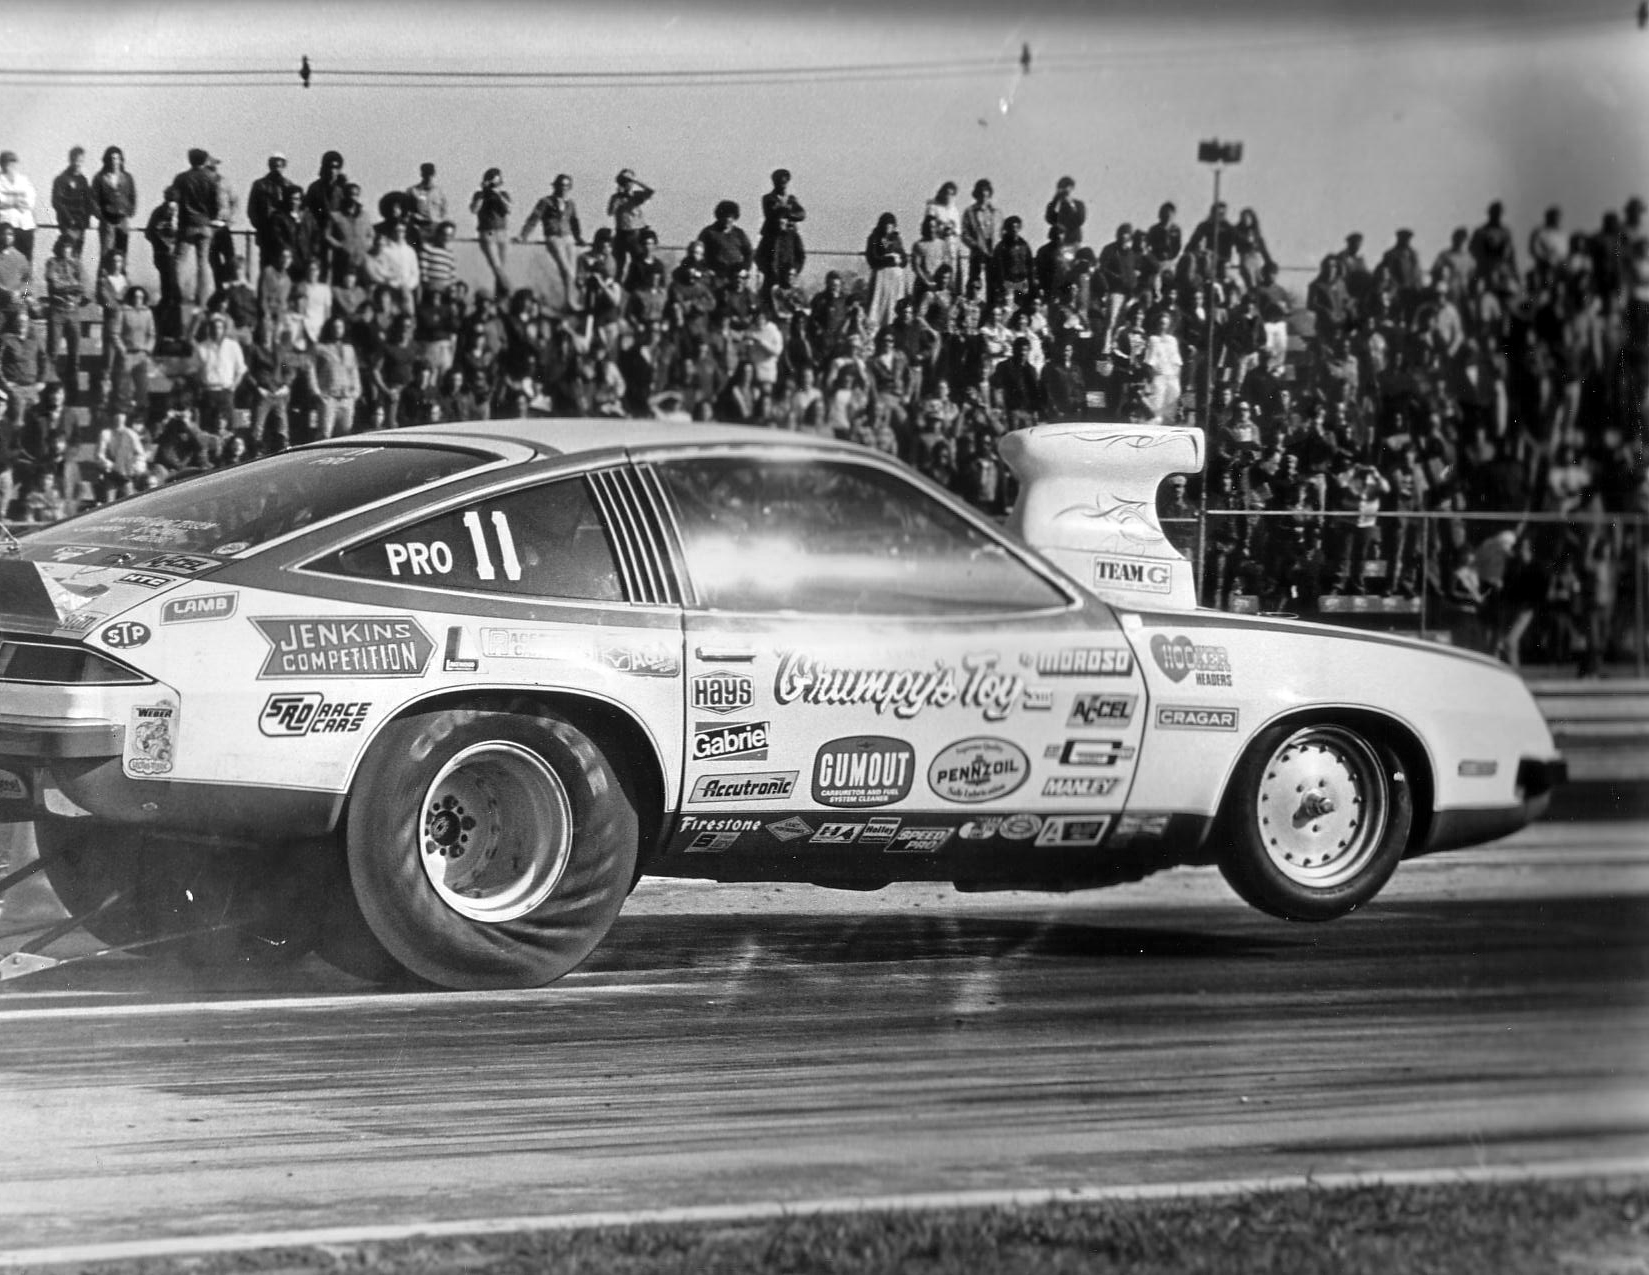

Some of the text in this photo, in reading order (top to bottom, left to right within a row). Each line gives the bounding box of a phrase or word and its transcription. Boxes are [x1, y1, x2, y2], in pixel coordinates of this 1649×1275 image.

[385, 510, 522, 581] PRO 11
[1096, 560, 1170, 584] TEAM G
[173, 597, 228, 614] LAMB
[107, 623, 145, 645] STP
[280, 623, 412, 651] JENKINS
[282, 641, 418, 672] COMPETITION
[1160, 643, 1232, 672] HOOKER
[773, 645, 1027, 722] Grumpy's Toy
[1195, 672, 1233, 687] HEADERS
[694, 678, 752, 706] Hays
[136, 707, 173, 718] WEBER
[265, 697, 317, 731] SRD
[317, 702, 373, 718] RACE
[1160, 711, 1233, 726] CRAGAR
[309, 717, 365, 733] CARS
[694, 722, 770, 757] Gabriel
[819, 751, 910, 787] GUMOUT
[937, 760, 1019, 785] PENNZOIL
[700, 777, 791, 798] Accutronic
[820, 788, 899, 797] CARBURETOR AND FUEL
[680, 816, 762, 833] Firestone
[865, 826, 895, 836] Holley
[899, 830, 945, 841] SPEED
[904, 841, 938, 850] PRO
